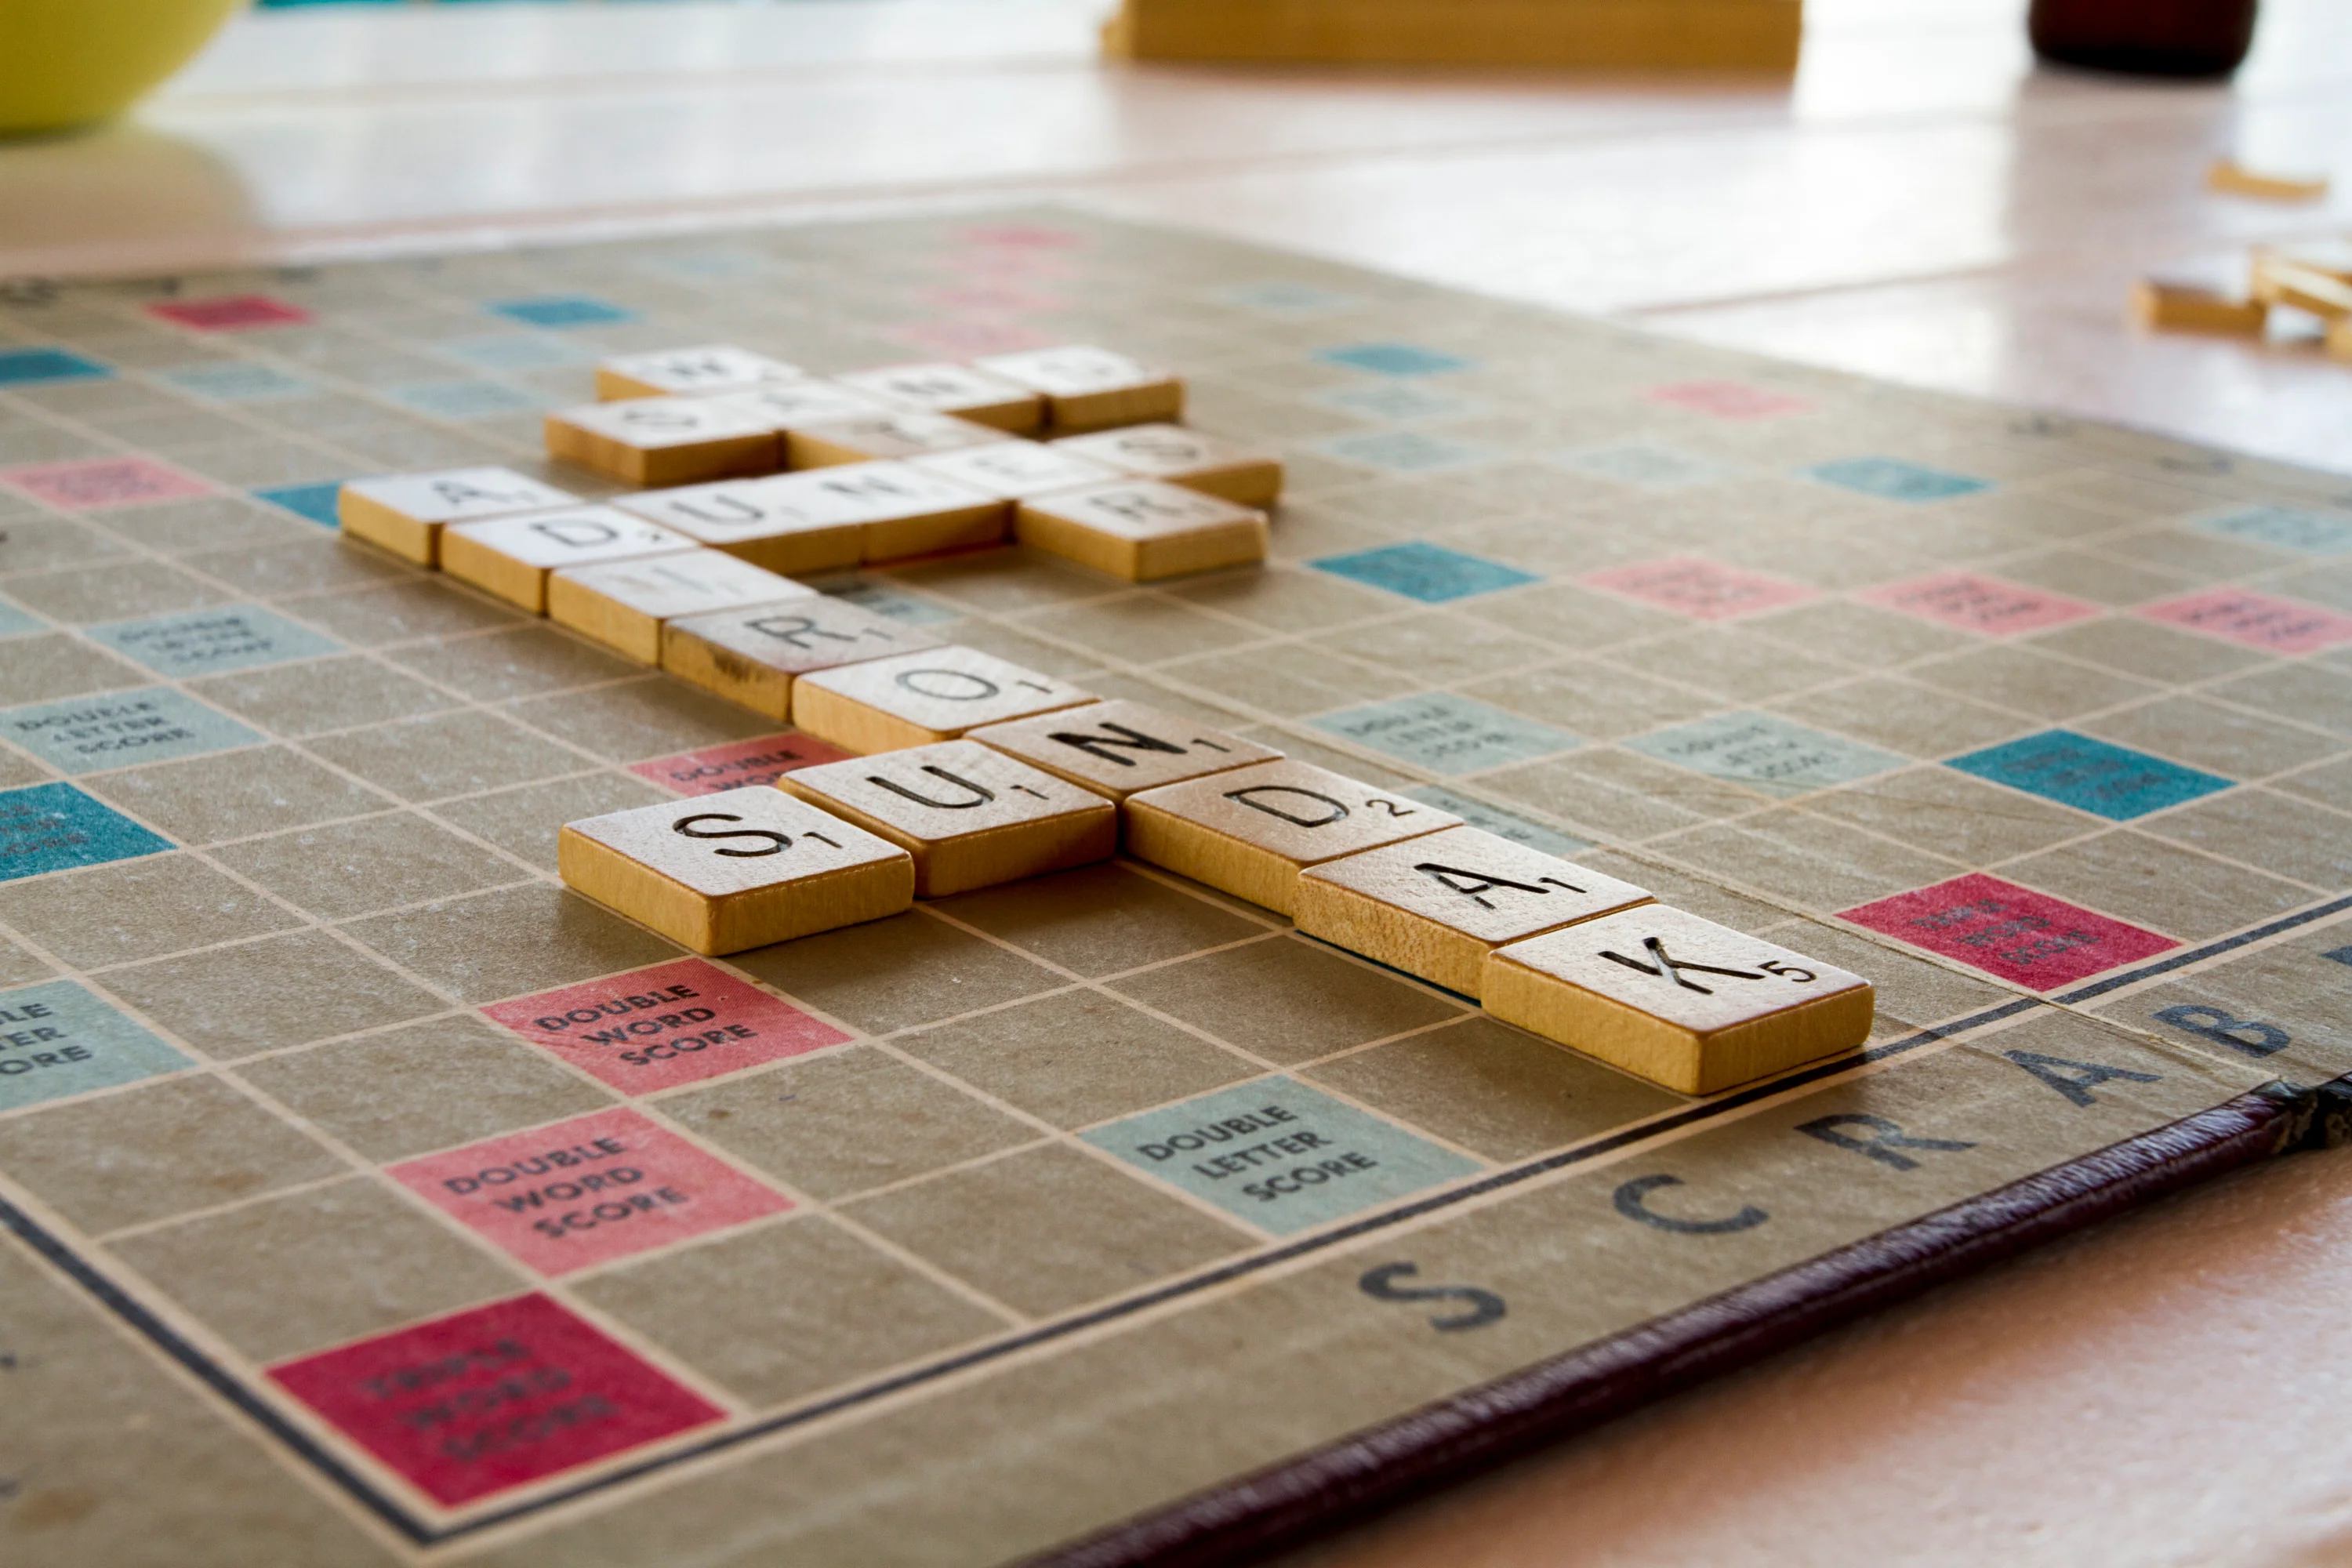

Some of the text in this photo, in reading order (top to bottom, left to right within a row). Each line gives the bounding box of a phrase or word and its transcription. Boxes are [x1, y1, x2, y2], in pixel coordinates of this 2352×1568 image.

[743, 615, 858, 650] R
[895, 668, 1000, 701] O
[1047, 721, 1188, 766] N
[866, 764, 995, 809] U
[1223, 784, 1350, 828] D
[672, 813, 793, 857] S
[1414, 862, 1548, 909] A
[1598, 936, 1766, 995] K
[533, 983, 701, 1033] DOUBLE
[581, 1006, 717, 1047] WORD
[620, 1023, 758, 1067] SCORE
[1136, 1104, 1298, 1163] DOUBLE
[1192, 1129, 1333, 1181] LETTER
[443, 1137, 628, 1196] DOUBLE
[495, 1164, 644, 1214] WORD
[1242, 1149, 1379, 1203] SCORE
[533, 1185, 691, 1240] SCORE
